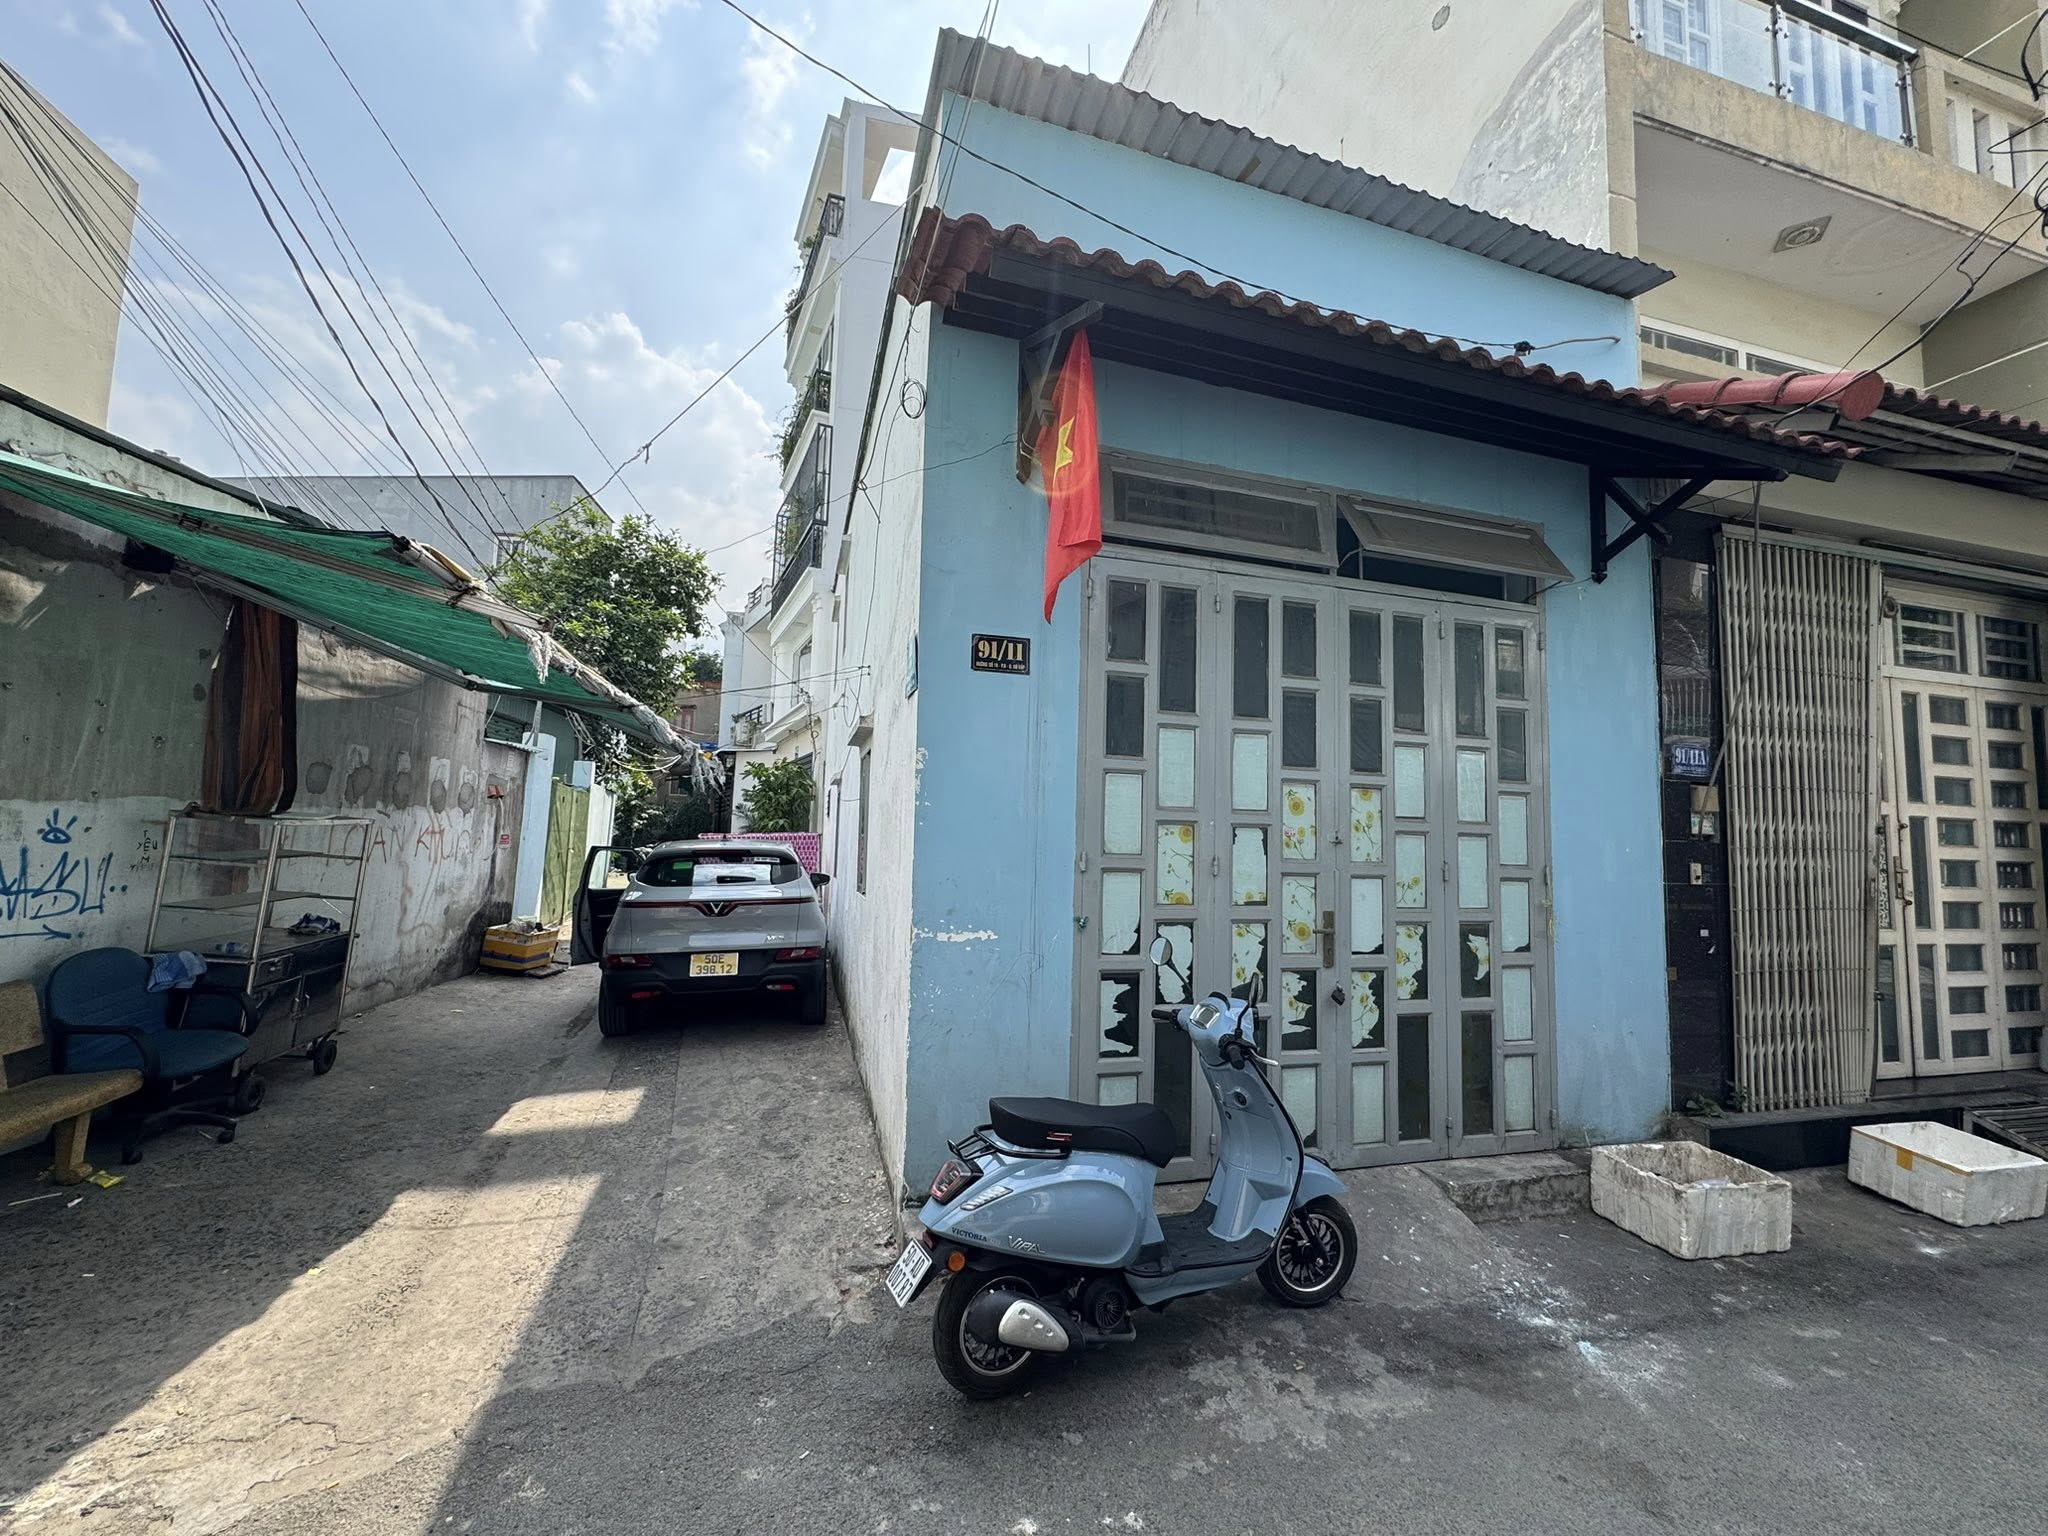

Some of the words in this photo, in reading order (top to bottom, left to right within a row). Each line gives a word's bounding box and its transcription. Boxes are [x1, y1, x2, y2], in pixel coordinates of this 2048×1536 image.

[978, 640, 1023, 661] 91/11
[1675, 747, 1706, 765] 91/11A
[704, 954, 725, 964] 50E
[695, 964, 733, 975] 398.12
[952, 1227, 987, 1242] VICTORIA
[1008, 1235, 1046, 1255] VIRAL
[887, 1263, 914, 1302] 007.87
